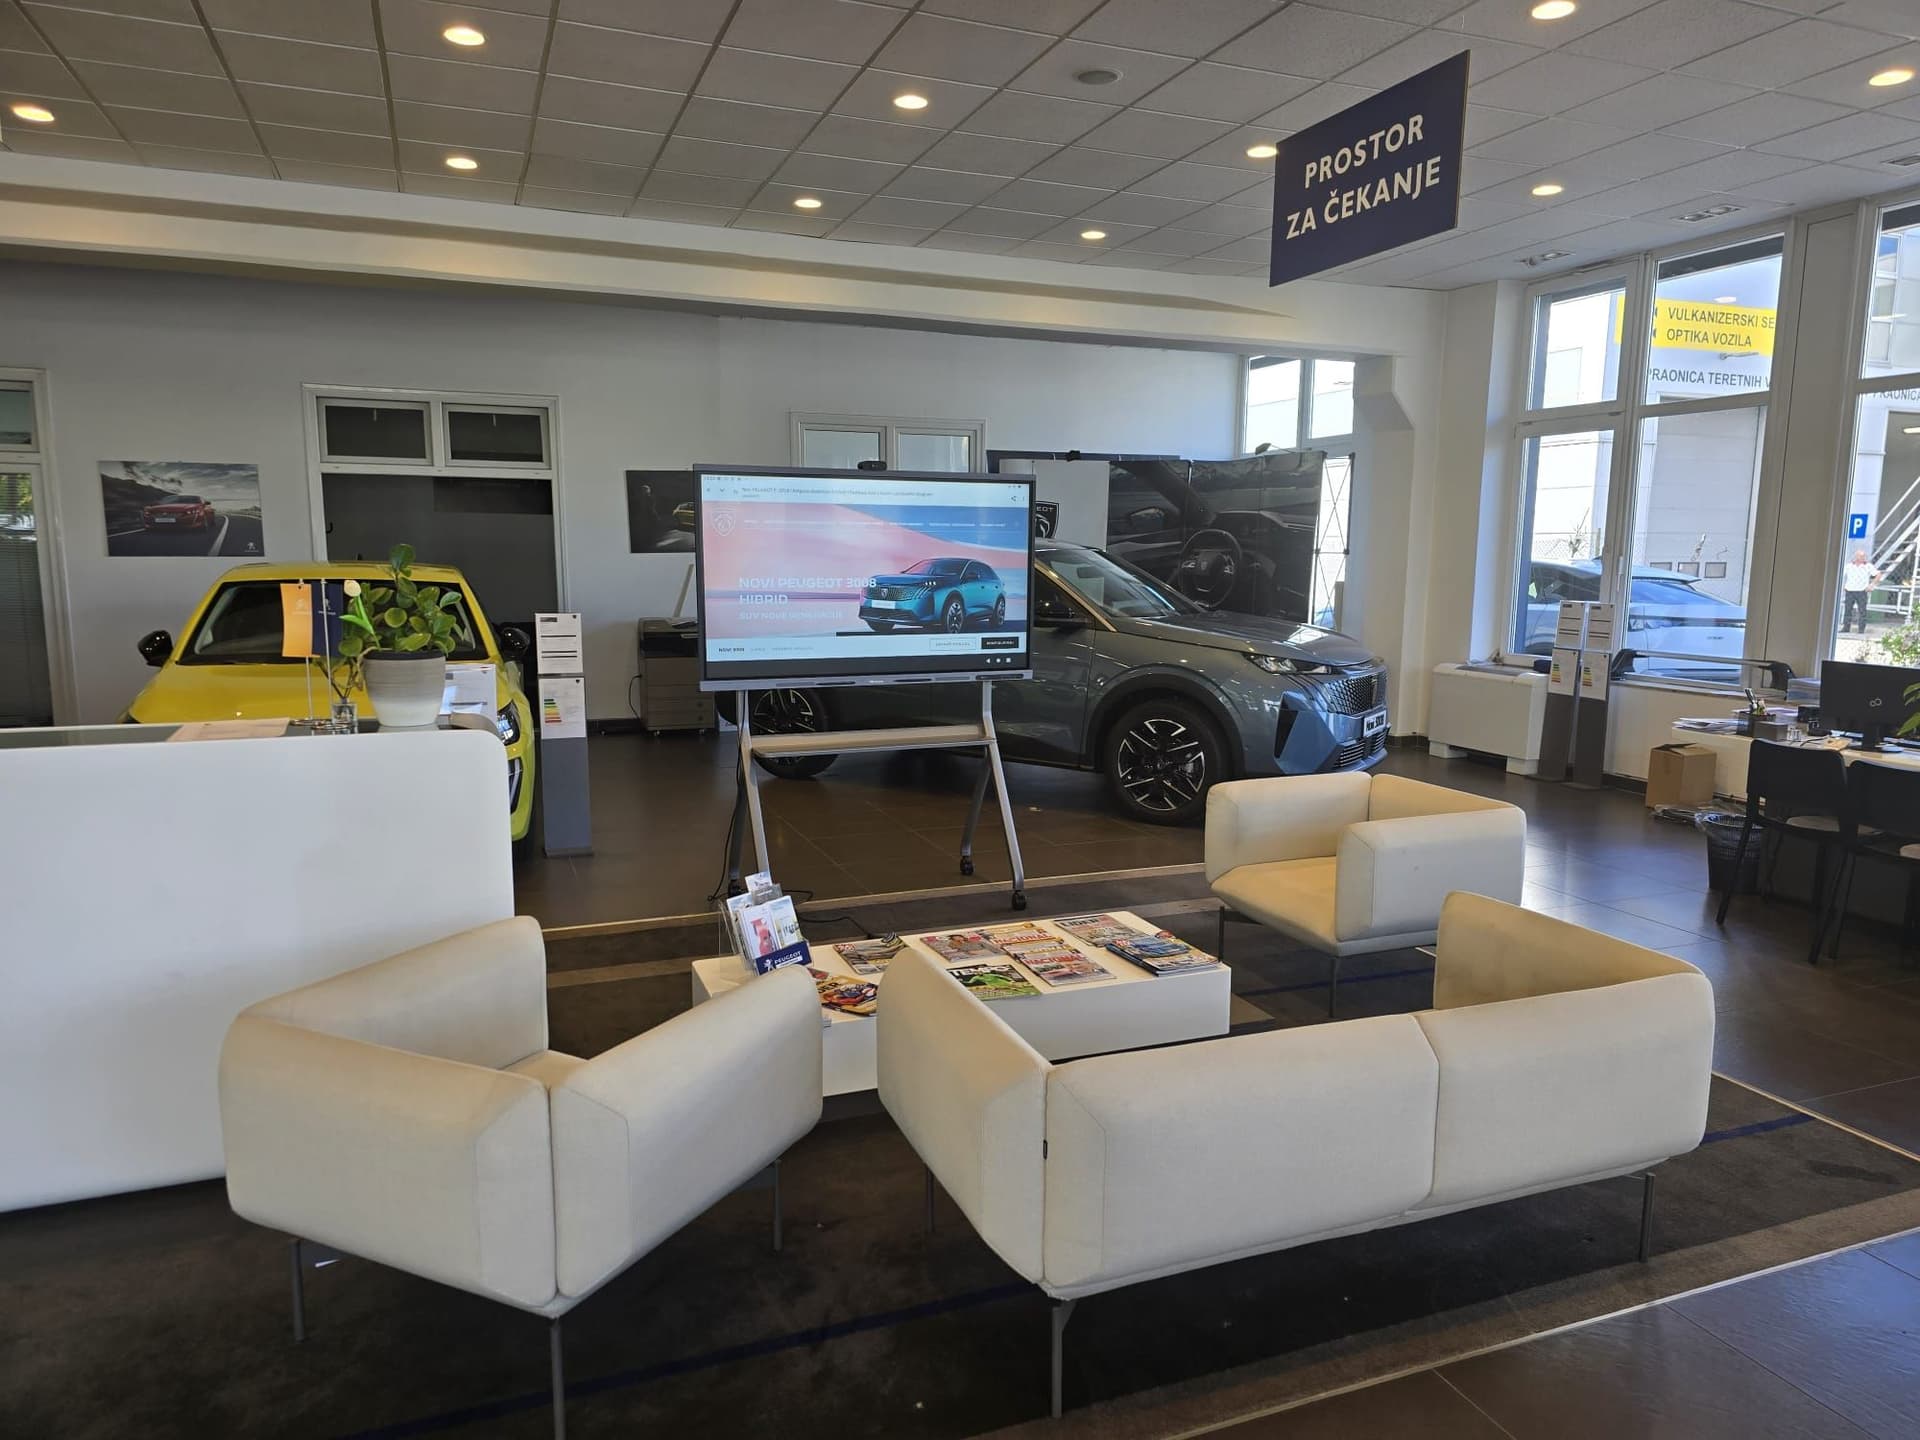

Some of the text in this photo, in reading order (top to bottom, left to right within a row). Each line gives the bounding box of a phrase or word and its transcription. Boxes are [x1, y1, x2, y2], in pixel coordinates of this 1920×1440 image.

[1305, 114, 1424, 189] PROSTOR
[1286, 156, 1441, 241] ZA ČEKANJE
[1668, 307, 1759, 327] VULKANIZERSKI
[1666, 328, 1752, 347] OPTIKA VOZILA
[1708, 372, 1761, 388] TERETNIH
[1853, 518, 1863, 535] P
[739, 577, 877, 589] NOVI PEUGEOT 3008
[739, 594, 789, 606] HIBRID
[774, 950, 802, 964] PEUGEOT
